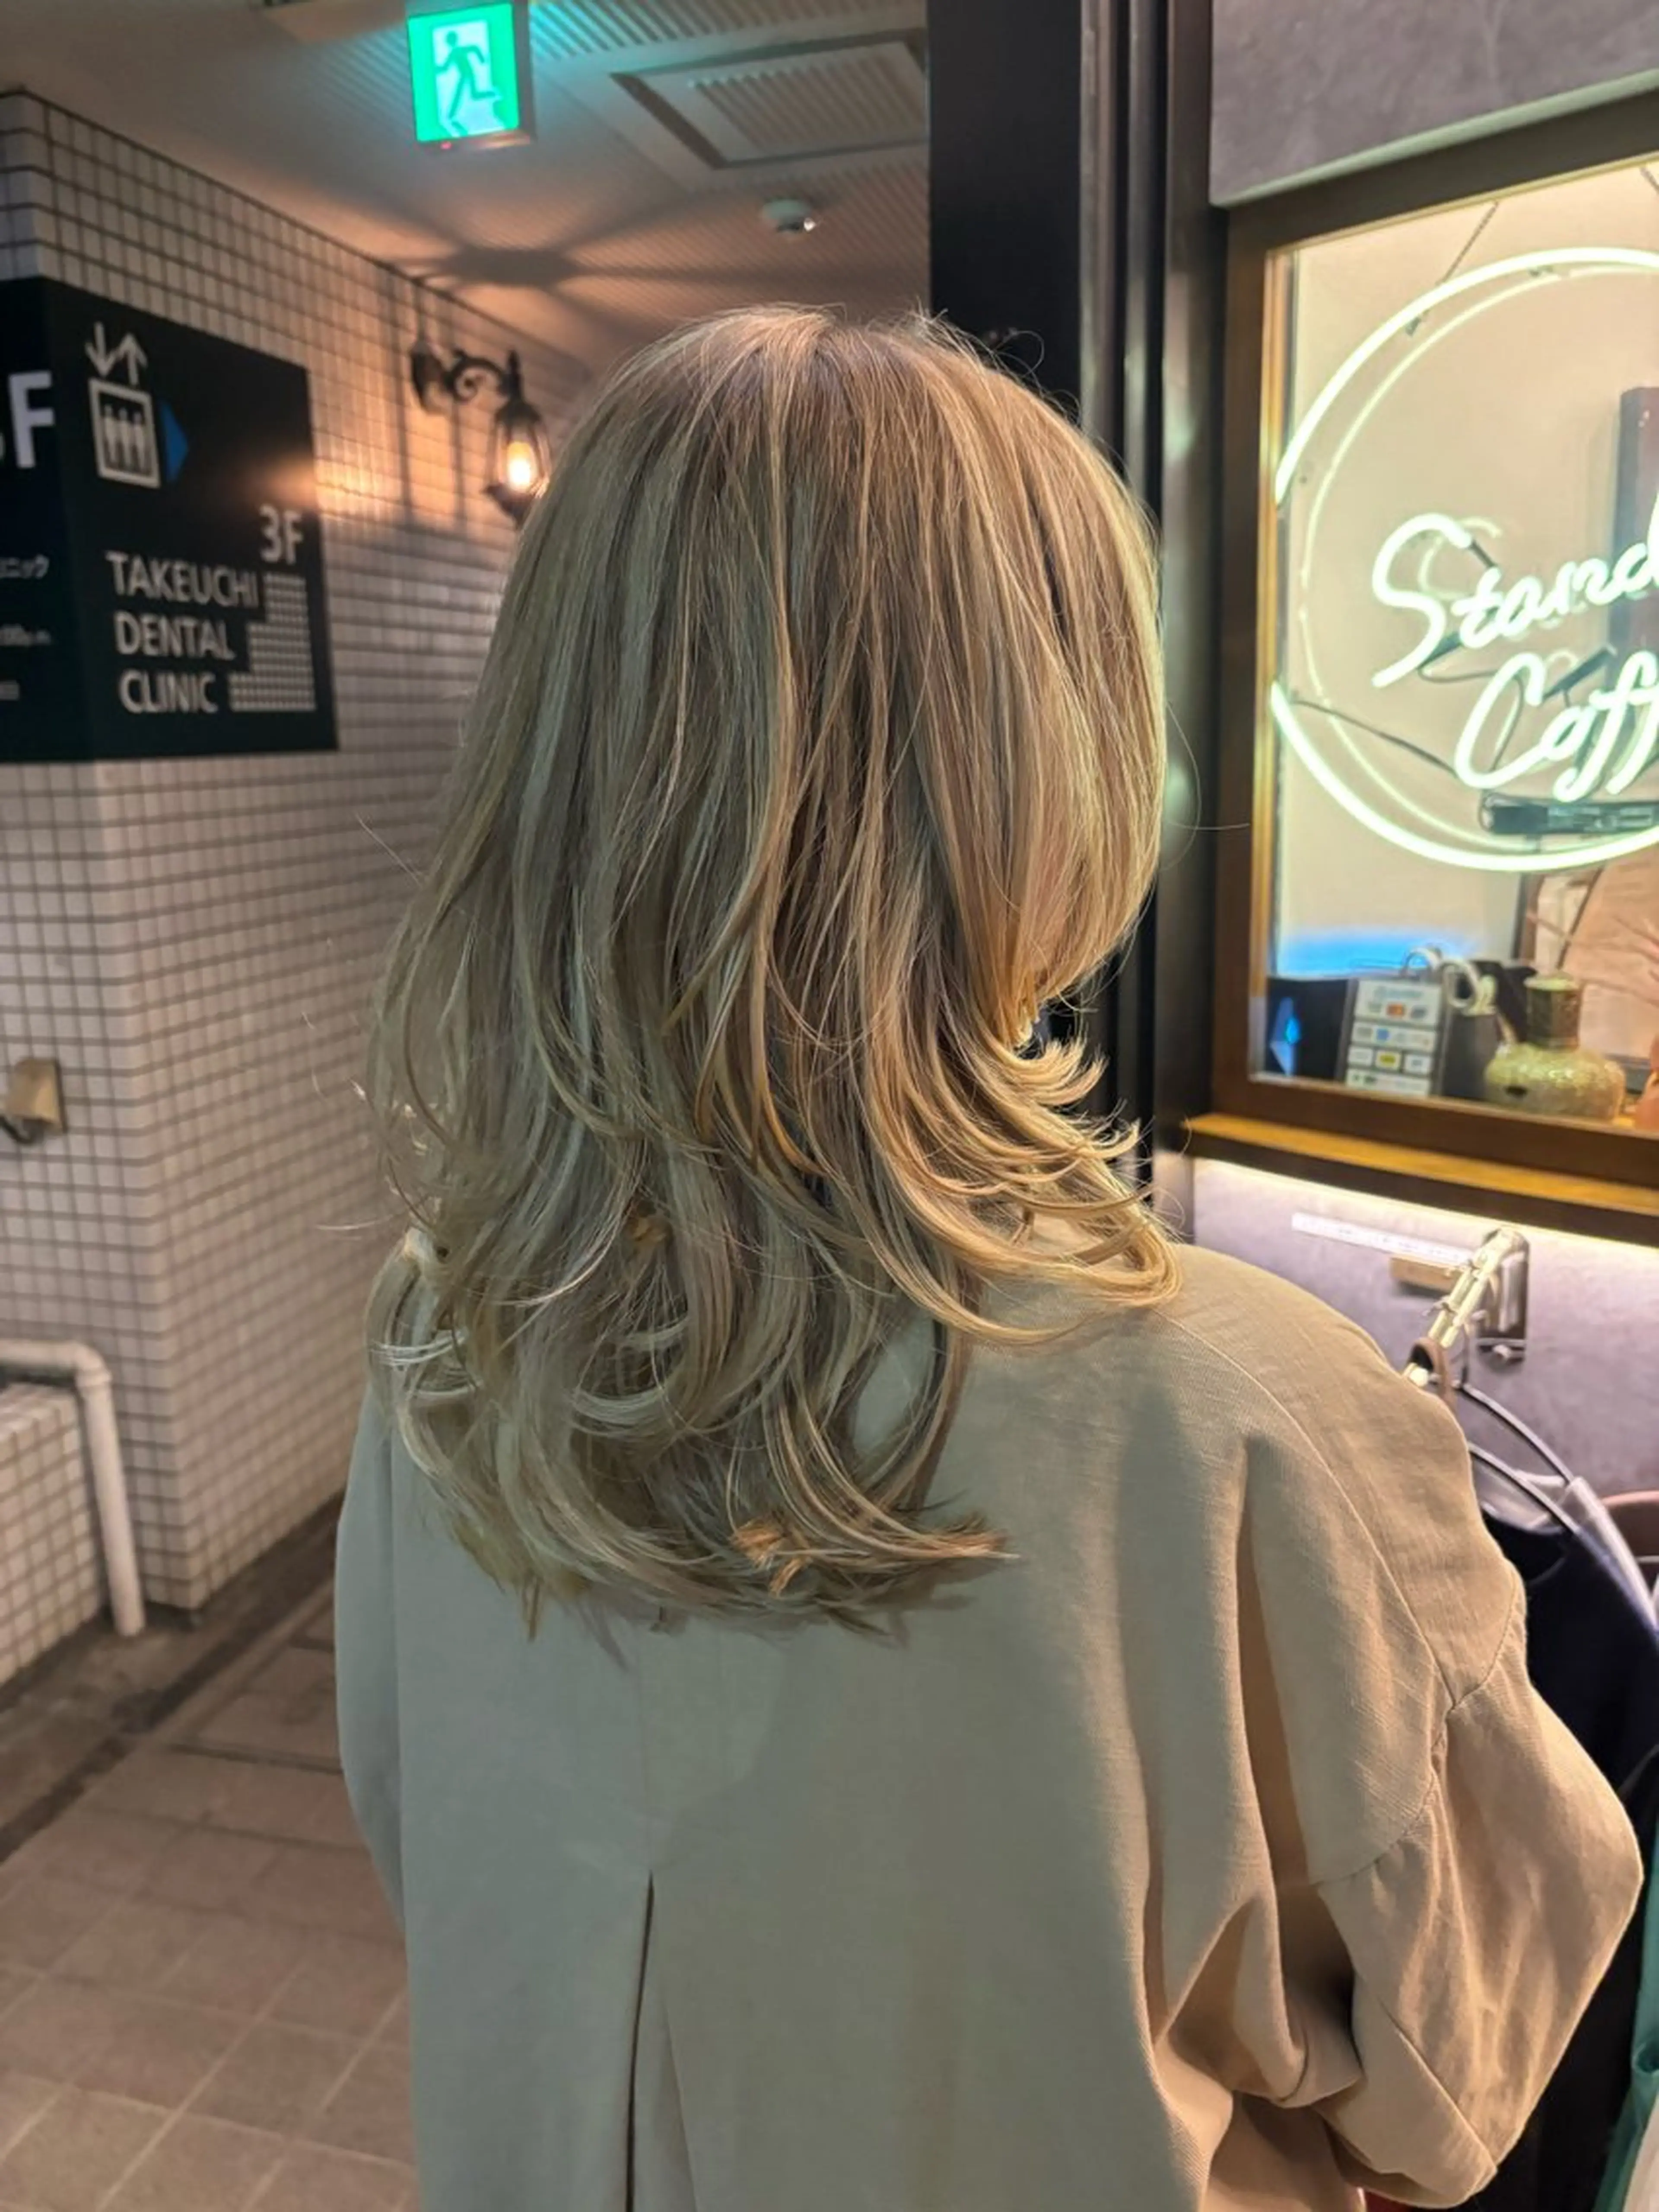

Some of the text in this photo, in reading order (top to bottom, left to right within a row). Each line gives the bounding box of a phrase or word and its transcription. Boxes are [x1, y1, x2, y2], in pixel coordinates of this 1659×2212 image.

[0, 370, 55, 468] F
[260, 505, 303, 564] 3F
[106, 550, 258, 608] TAKEUCHI
[114, 610, 236, 661] DENTAL
[119, 668, 218, 714] CLINIC
